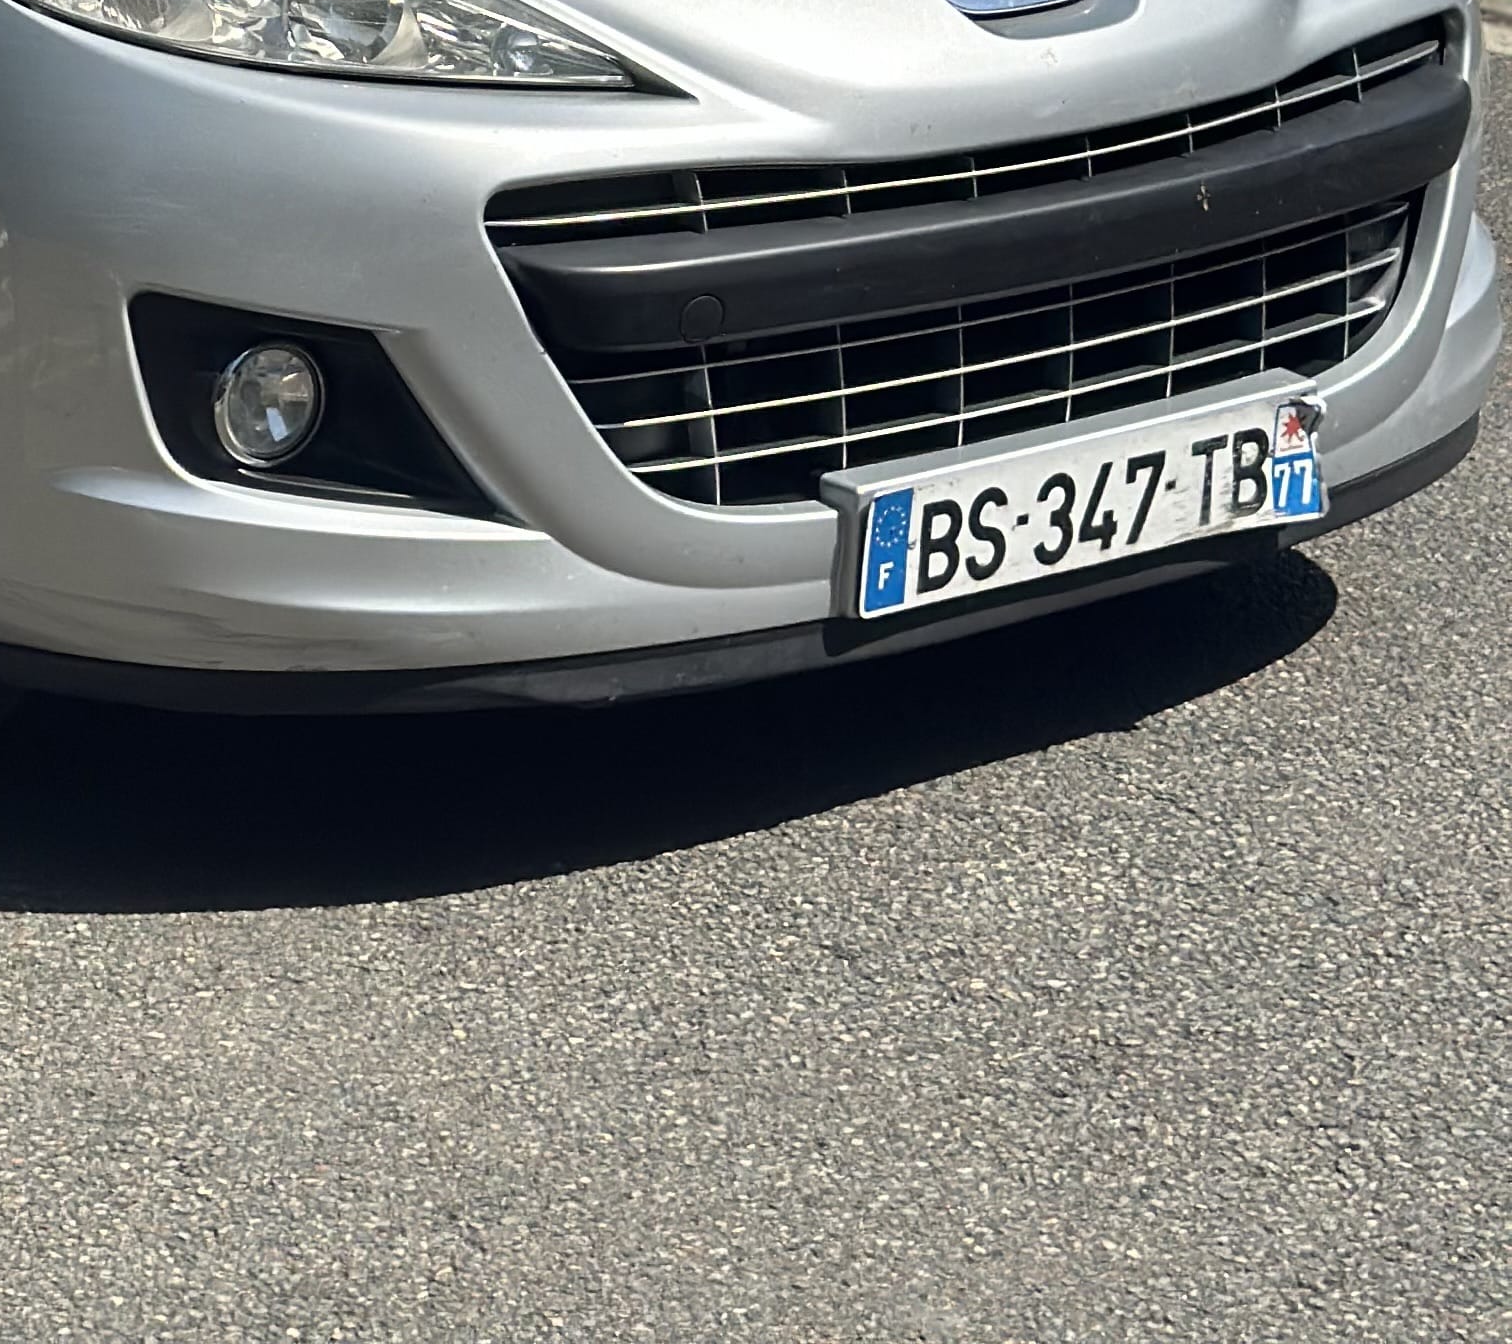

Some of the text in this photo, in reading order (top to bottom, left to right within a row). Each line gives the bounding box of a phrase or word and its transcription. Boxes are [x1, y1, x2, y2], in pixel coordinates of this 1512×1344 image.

[877, 427, 1313, 596] F BS-347-TB 77
